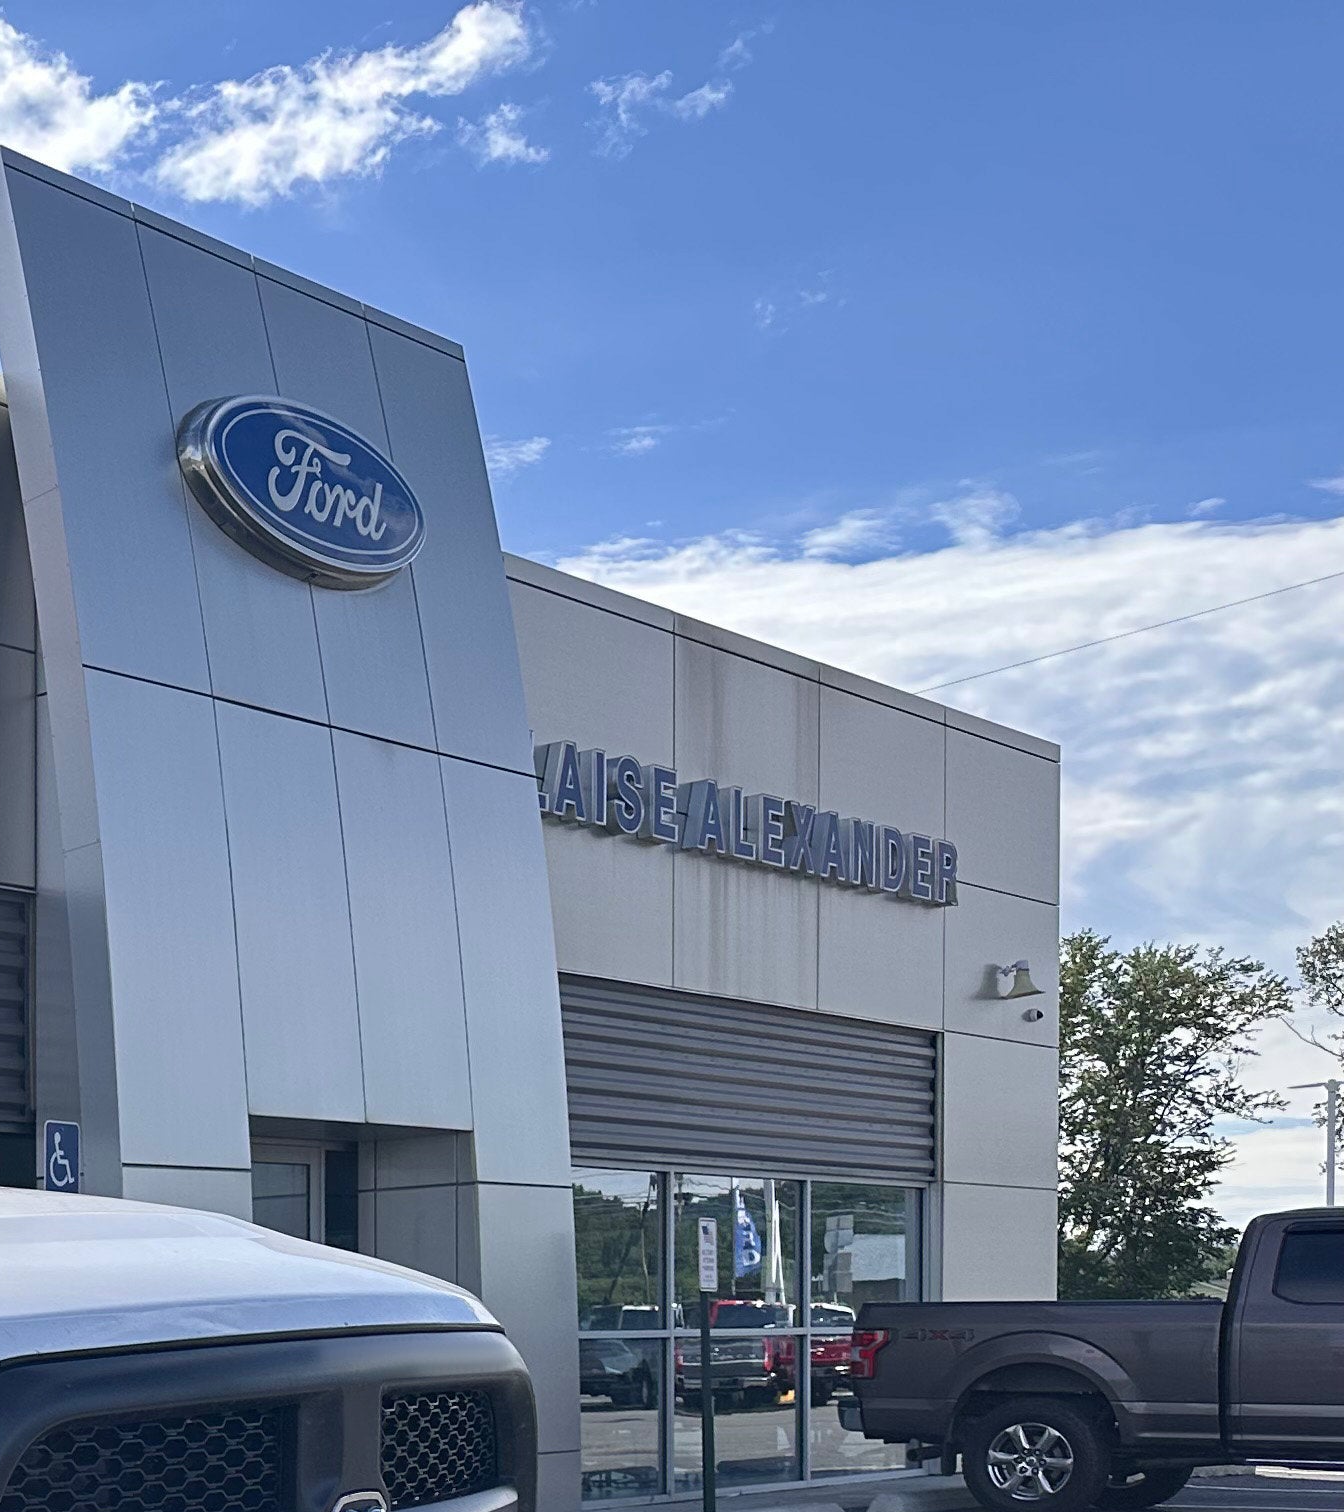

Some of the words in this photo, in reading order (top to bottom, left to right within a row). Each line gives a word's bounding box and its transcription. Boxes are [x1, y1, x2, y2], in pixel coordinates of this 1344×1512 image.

[267, 429, 387, 541] Ford
[538, 740, 678, 842] AISE
[690, 779, 959, 904] ALEXANDER
